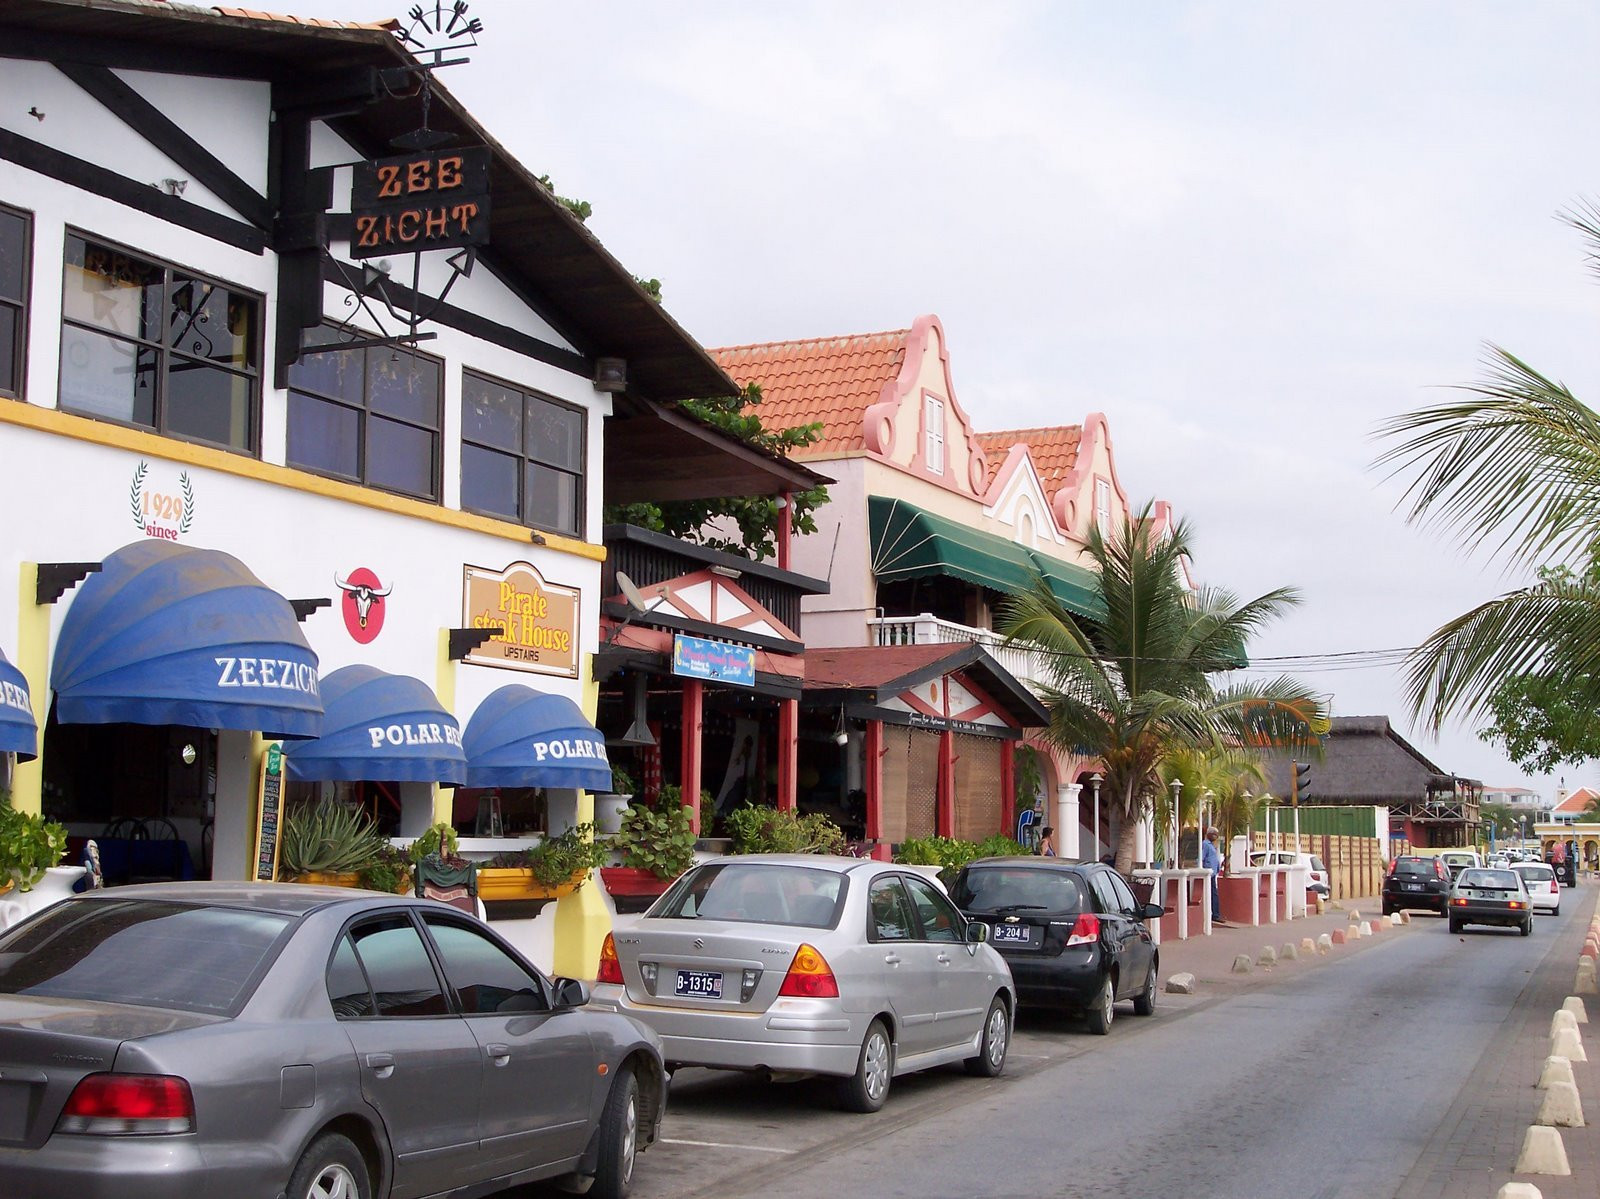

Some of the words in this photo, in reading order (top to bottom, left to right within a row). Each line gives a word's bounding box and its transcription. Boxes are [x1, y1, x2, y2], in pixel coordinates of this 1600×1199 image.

[377, 156, 463, 198] ZEE
[356, 203, 479, 247] ZICHT
[143, 490, 183, 522] 1929
[146, 520, 178, 540] since
[498, 581, 547, 618] Pirate
[520, 613, 570, 652] House
[504, 646, 540, 661] UPSTAIRS
[214, 656, 318, 696] ZEEZICH
[368, 723, 444, 749] POLAR
[443, 724, 464, 751] BE
[533, 739, 596, 762] POLAR
[594, 741, 609, 764] BE
[677, 975, 714, 992] B-1315
